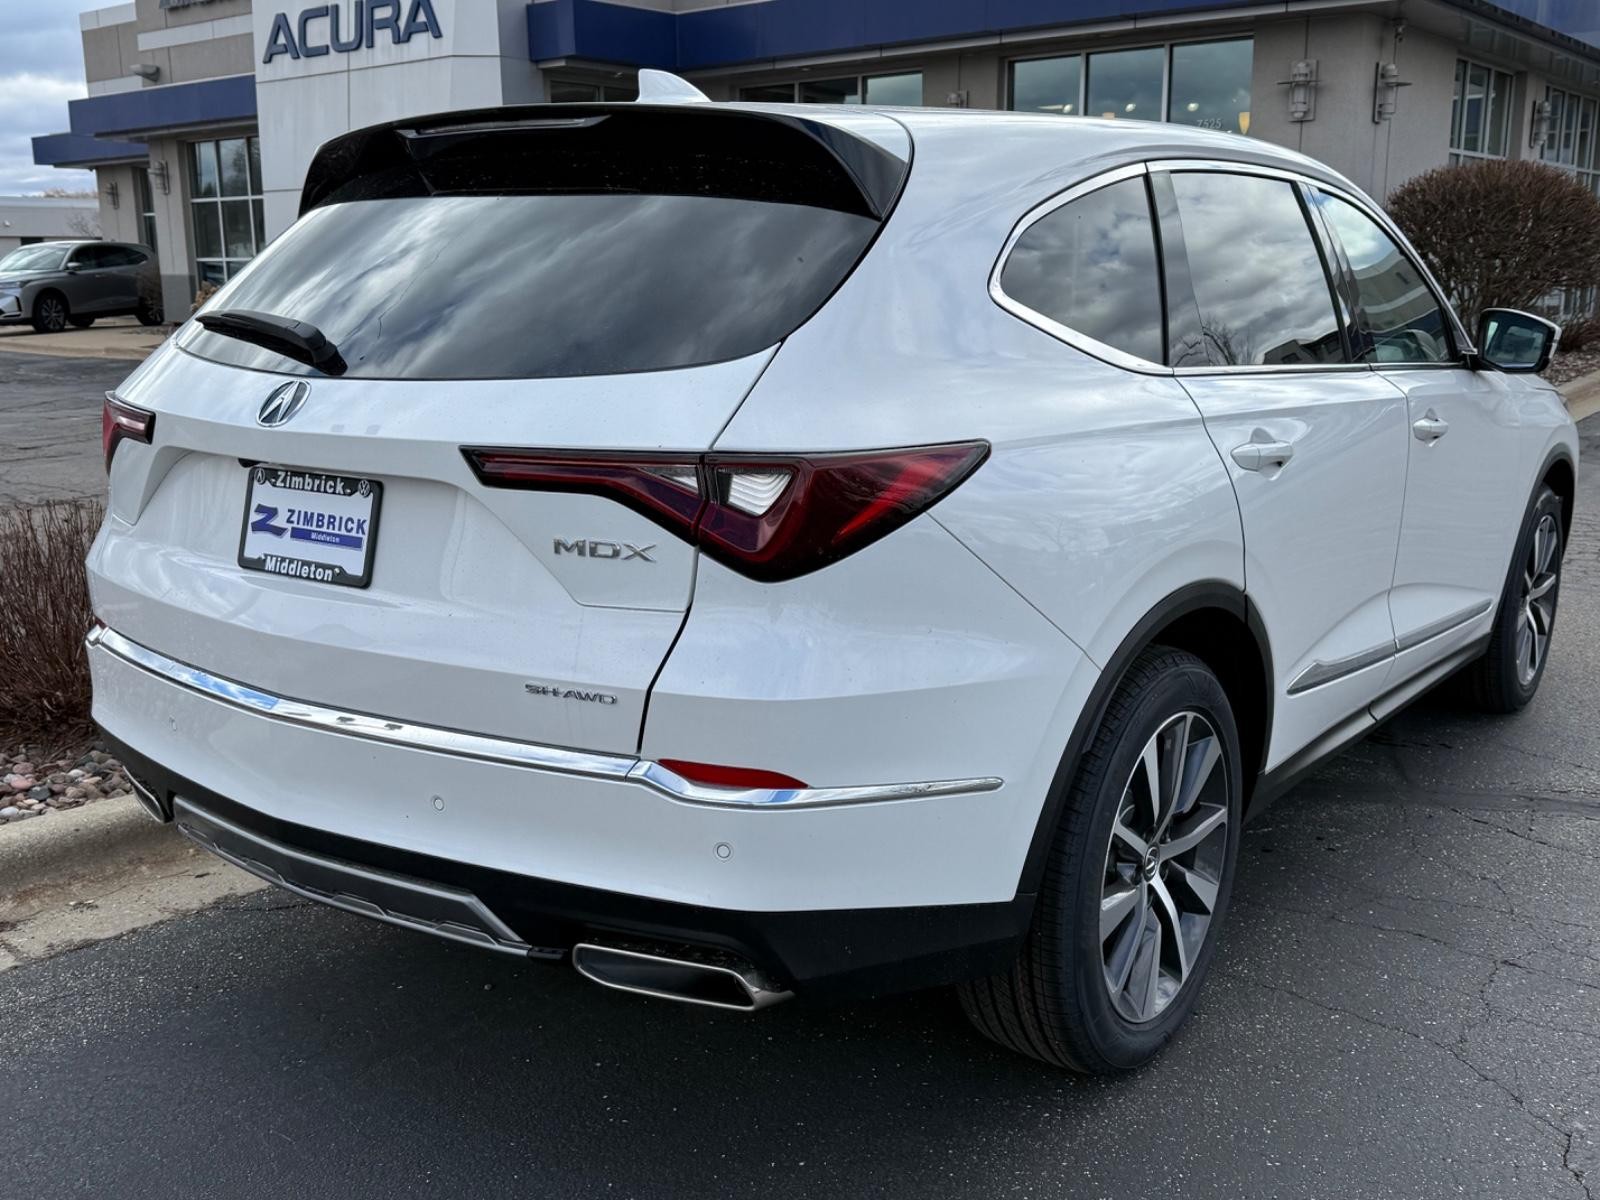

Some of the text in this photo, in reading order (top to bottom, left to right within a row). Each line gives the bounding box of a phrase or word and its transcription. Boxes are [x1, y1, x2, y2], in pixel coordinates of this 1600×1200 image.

[263, 0, 443, 64] ACURA
[286, 509, 367, 535] ZIMBRICK
[311, 532, 340, 543] Middleton
[553, 538, 656, 563] MDX
[264, 554, 333, 582] Middleton
